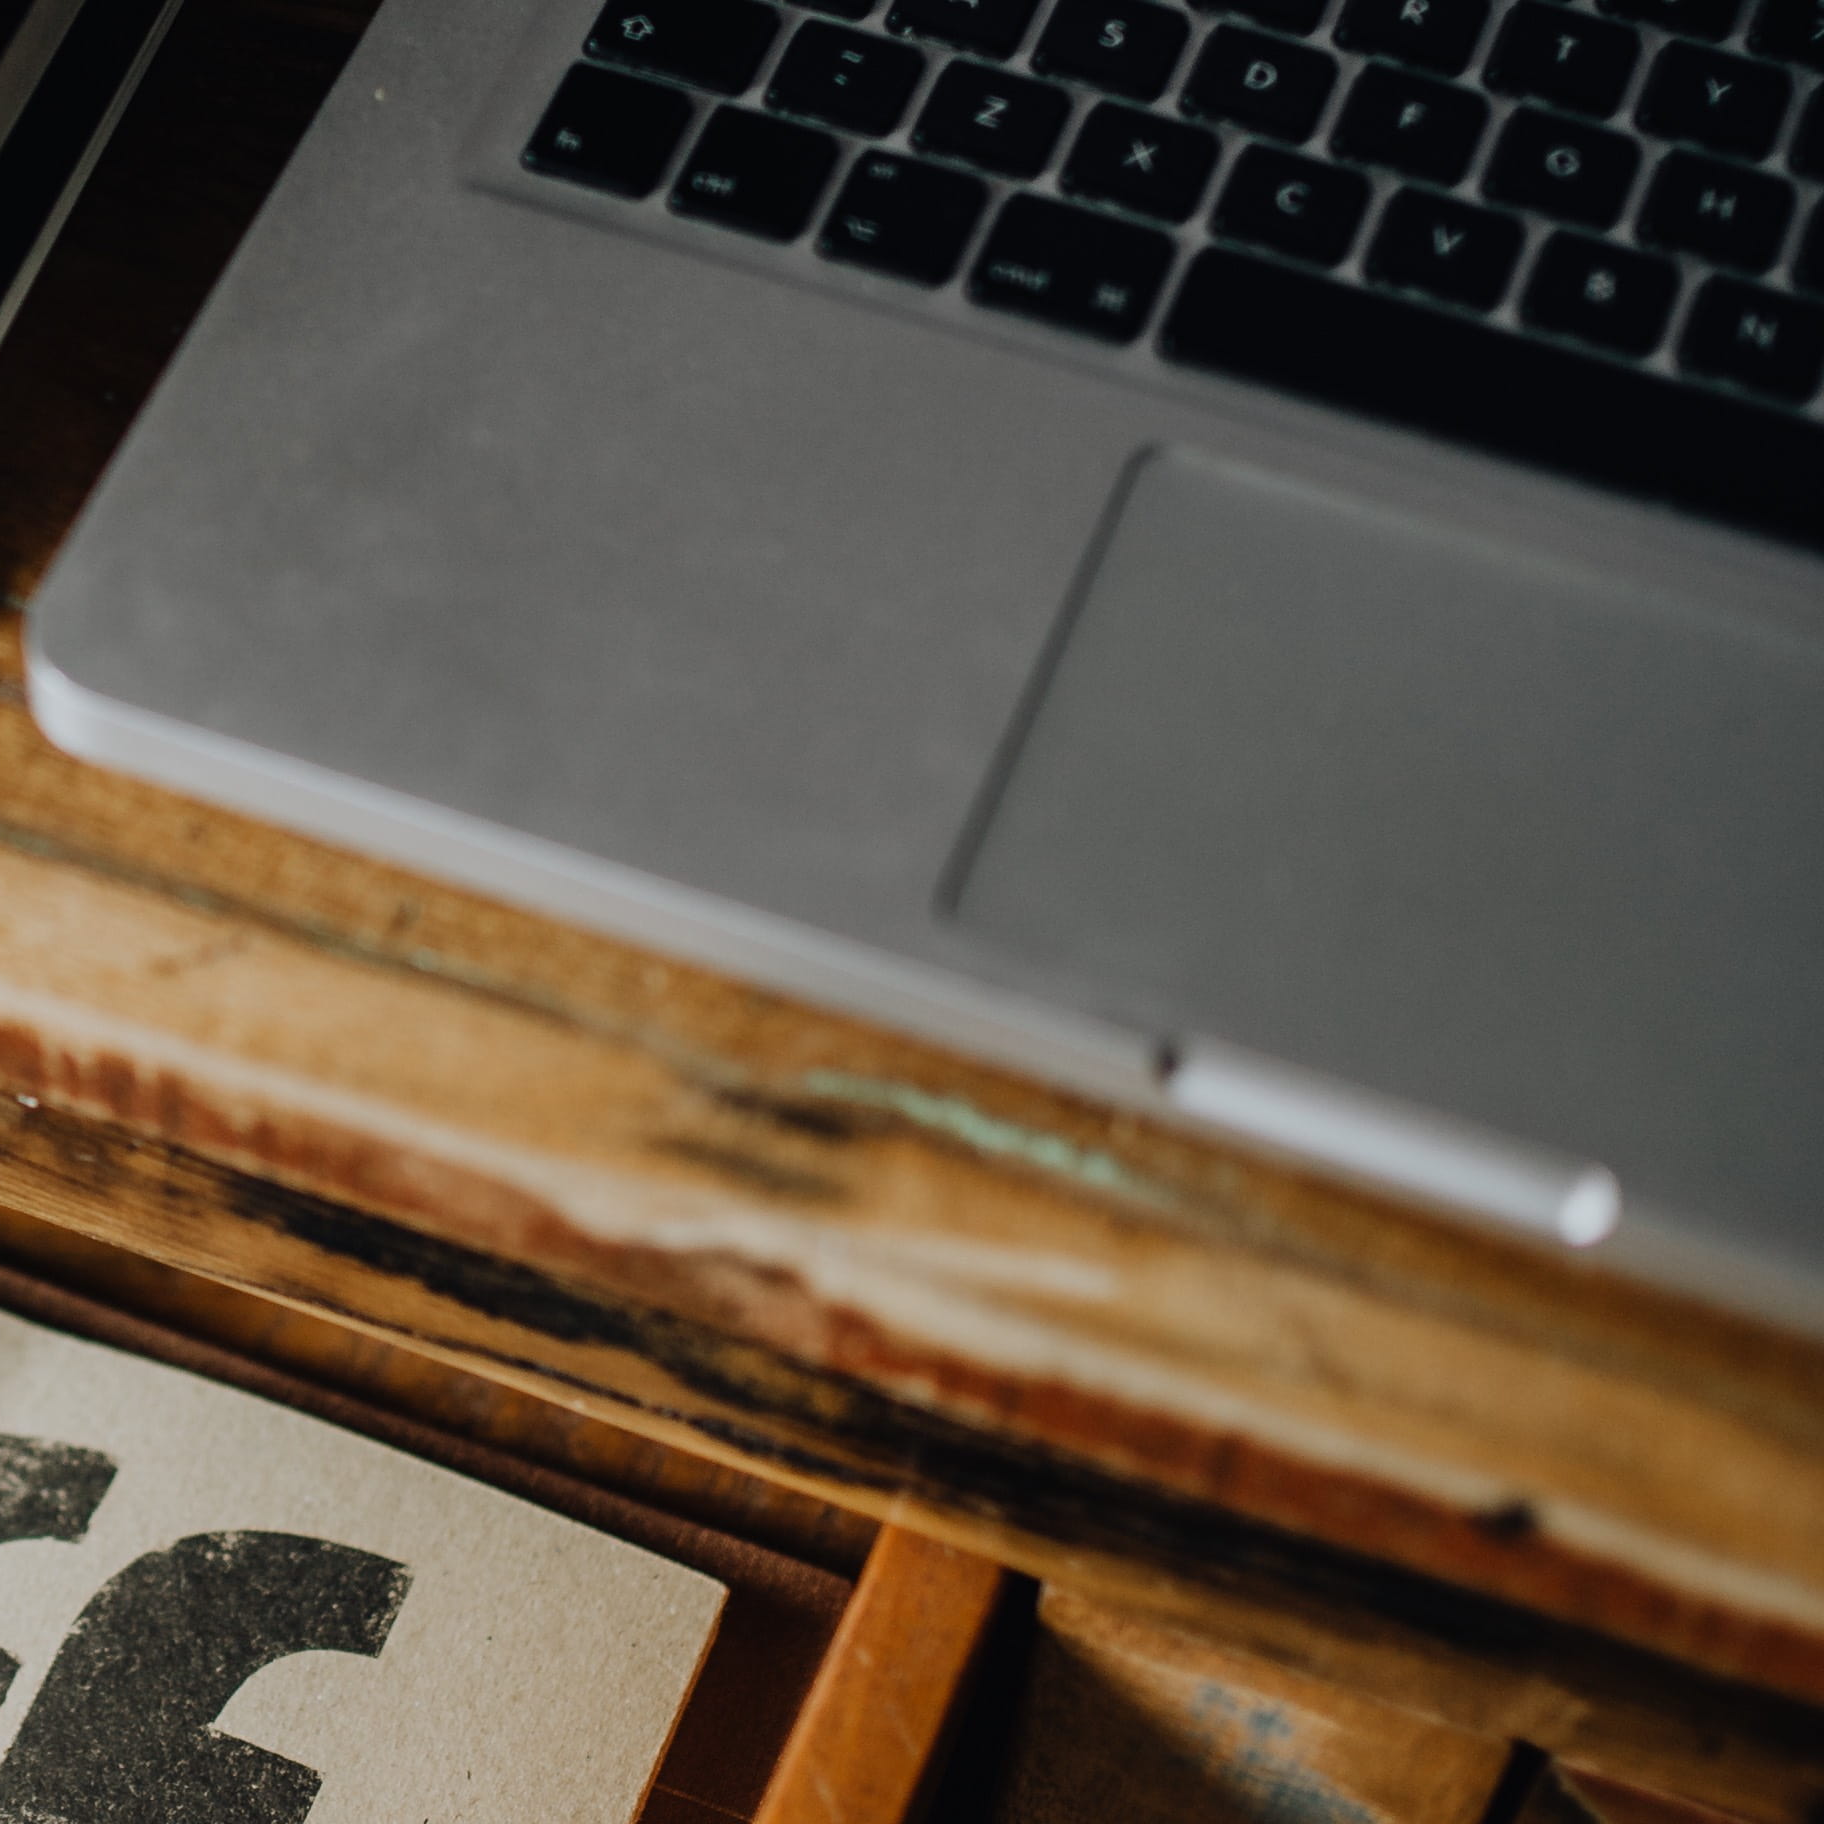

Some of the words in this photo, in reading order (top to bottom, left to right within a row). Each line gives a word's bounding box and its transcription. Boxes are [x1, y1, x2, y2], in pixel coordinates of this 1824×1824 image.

[1101, 21, 1124, 48] S
[1244, 61, 1278, 89] D
[1706, 77, 1733, 105] Y
[975, 96, 1007, 128] Z
[1126, 143, 1155, 170] X
